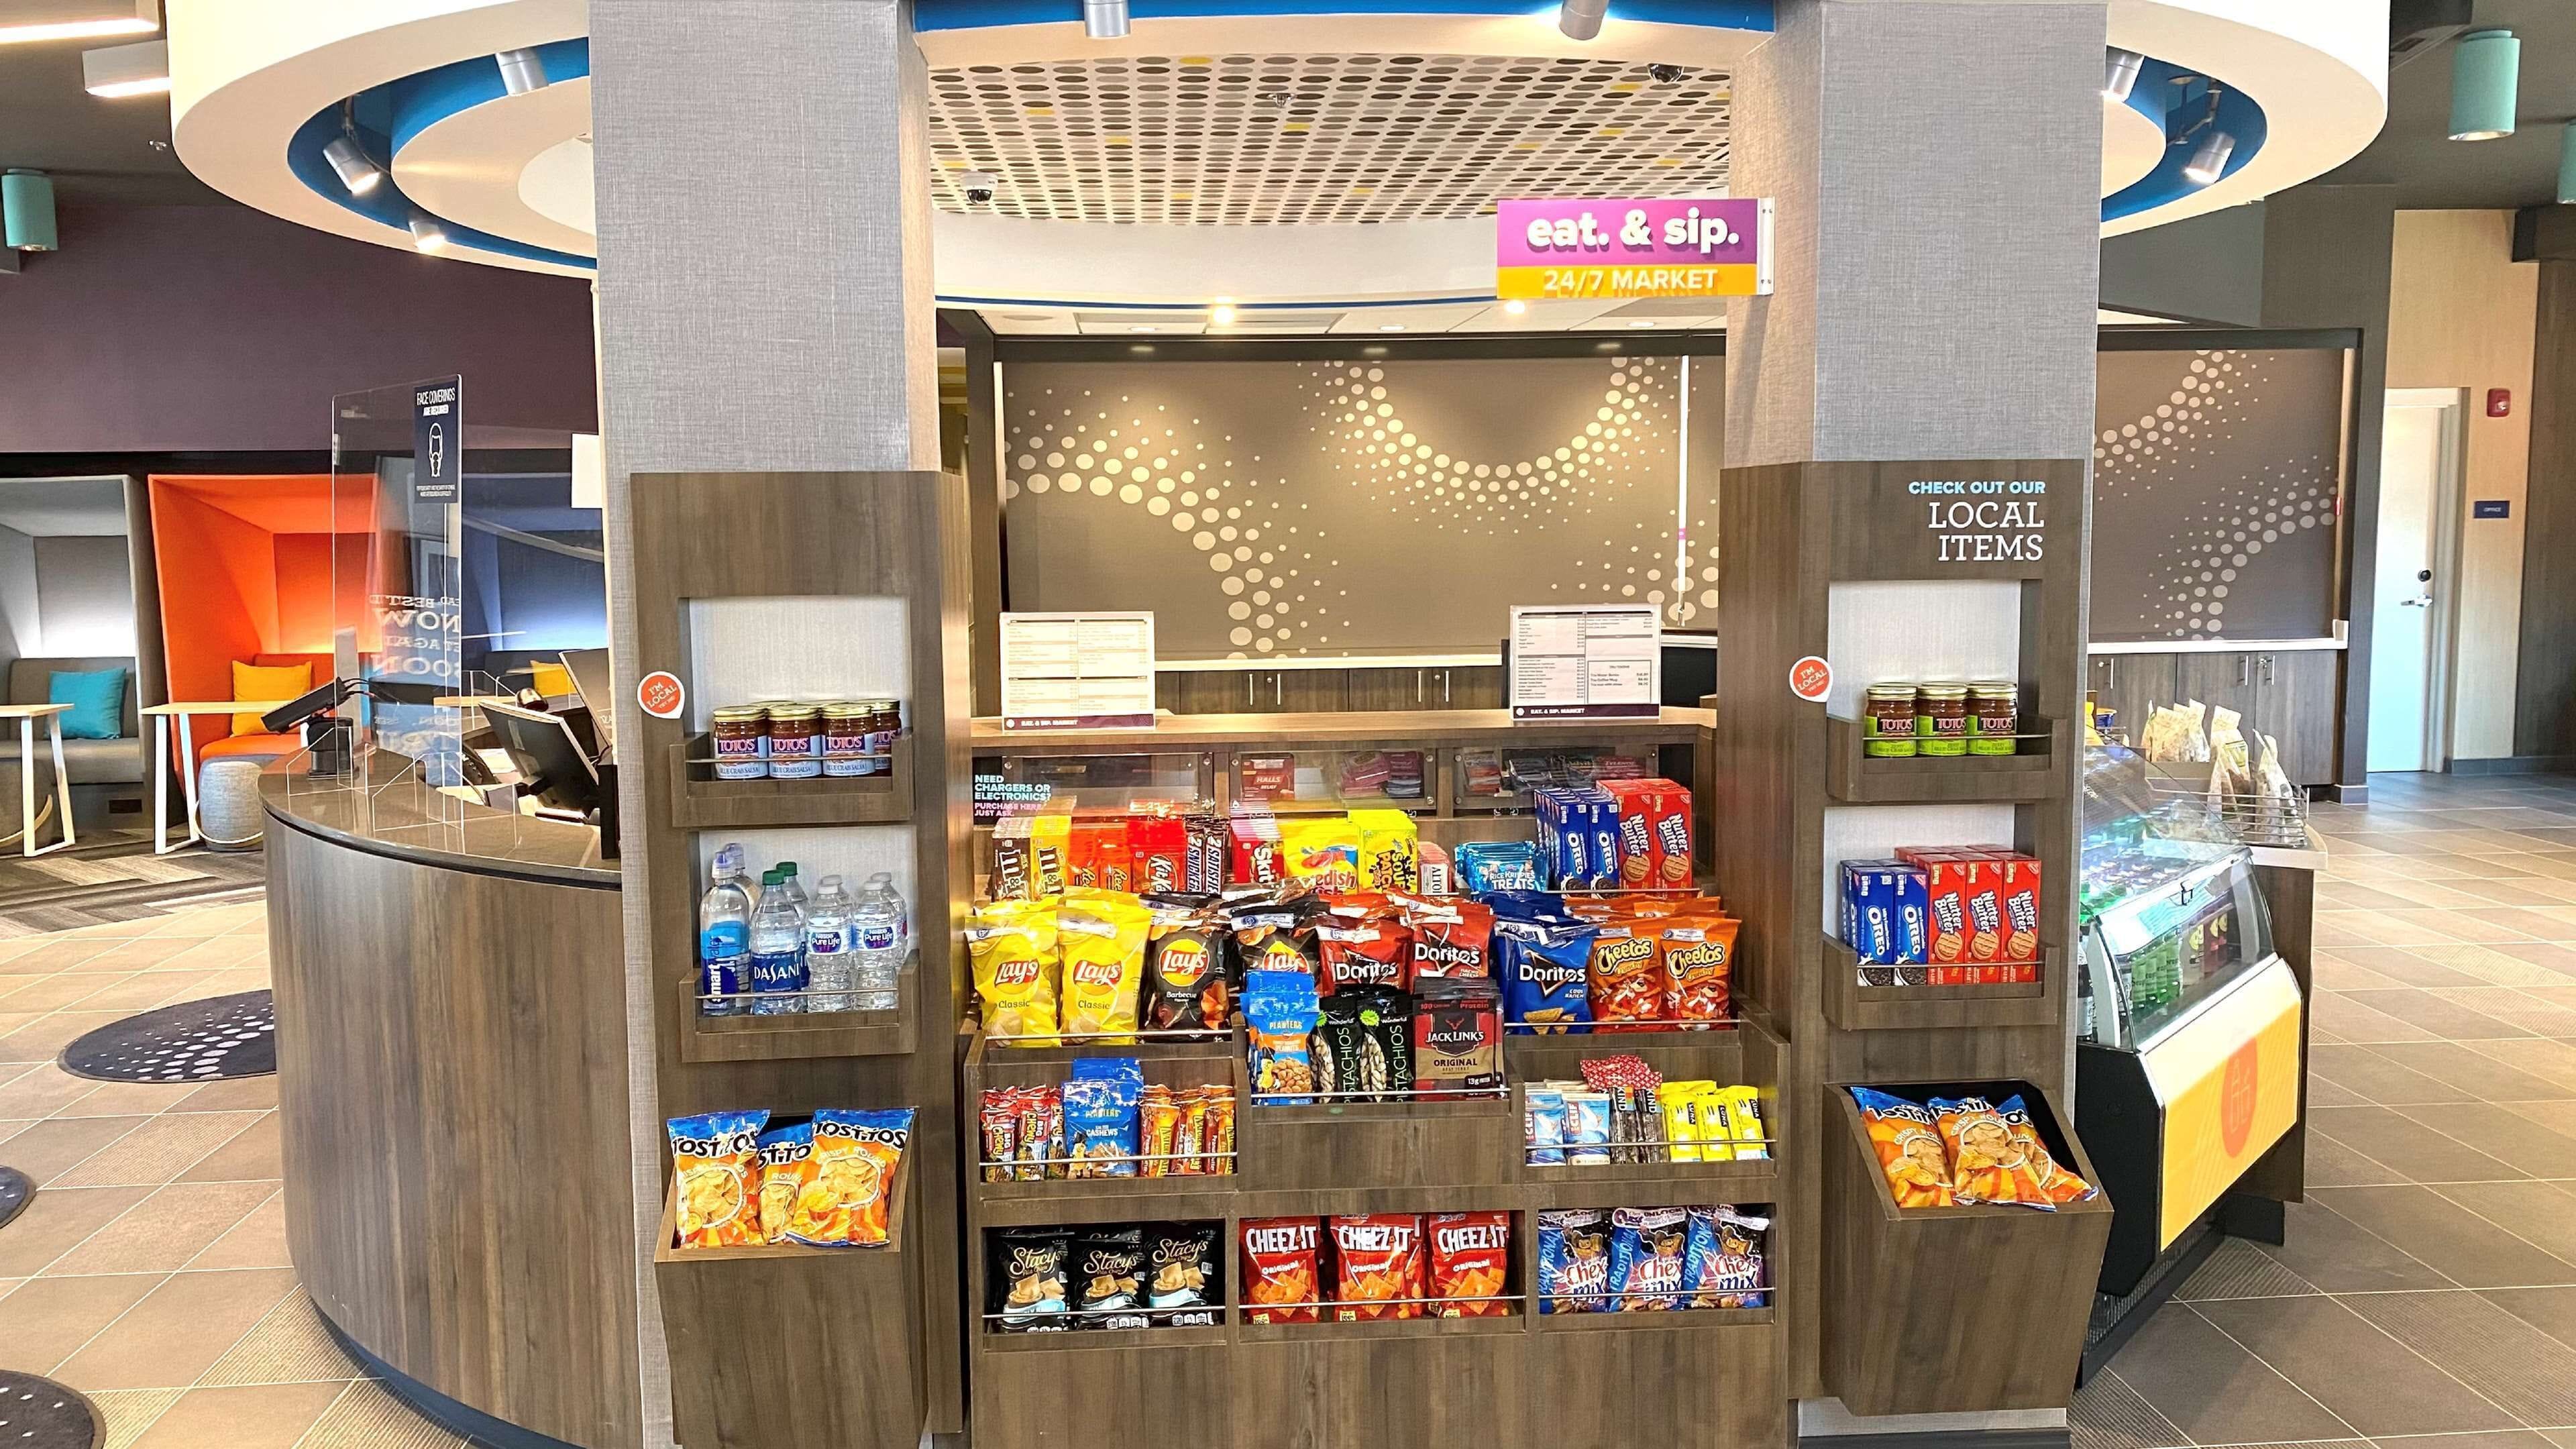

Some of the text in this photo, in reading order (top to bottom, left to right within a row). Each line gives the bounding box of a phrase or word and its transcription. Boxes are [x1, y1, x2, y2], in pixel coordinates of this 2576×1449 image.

[1527, 207, 1739, 253] eat. & sip.
[1544, 269, 1717, 290] 24/7 MARKET
[417, 387, 455, 406] FACE COVERINGS
[1909, 481, 2046, 494] CHECK OUT OUR
[1928, 501, 2045, 529] LOCAL
[1938, 534, 2044, 561] ITEMS
[1797, 669, 1827, 691] LOCAL
[1801, 665, 1815, 679] I'M
[646, 685, 677, 708] LOCAL
[648, 682, 663, 696] I'M
[975, 775, 1004, 783] NEED
[975, 784, 1051, 792] CHARGERS OR
[975, 792, 1052, 801] ELECTRONICS?
[1619, 820, 1642, 856] Butter
[1629, 814, 1650, 851] Nutter
[1658, 820, 1680, 855] Butter
[1669, 814, 1688, 851] Nutter
[1567, 833, 1582, 874] OREO
[1598, 832, 1613, 873] OREO
[1149, 857, 1174, 893] KitKa
[1188, 847, 1201, 892] SNICKER
[1254, 847, 1273, 883] Skit
[1490, 872, 1503, 880] RICE
[1432, 867, 1442, 894] ALTOI
[1492, 879, 1535, 890] TREATS
[1934, 899, 1954, 934] Butter
[1945, 892, 1962, 928] Nutter
[1970, 897, 1990, 932] Butter
[1981, 891, 1999, 927] Nutter
[2008, 896, 2028, 932] Butter
[2019, 891, 2036, 927] Nutter
[828, 936, 841, 947] Life
[881, 932, 893, 942] Life
[1868, 907, 1885, 955] OREO
[1904, 906, 1921, 955] OREO
[1162, 950, 1207, 975] Lay's
[1415, 943, 1480, 964] Doritos
[1595, 940, 1652, 974] Cheetos
[1670, 943, 1725, 978] Cheetos
[754, 963, 800, 983] DASANI
[996, 961, 1038, 985] Lay's
[1075, 960, 1122, 985] Lay's
[1336, 962, 1397, 980] Doritos
[1520, 965, 1585, 983] Doritos
[998, 1000, 1030, 1009] Classic
[1078, 1000, 1111, 1010] Classic
[1167, 991, 1197, 999] Barbecue
[1269, 1020, 1303, 1030] PLANTERS
[1426, 1032, 1453, 1042] JACK
[1434, 1059, 1477, 1067] ORIGINAL
[1617, 1087, 1626, 1111] KIND
[1647, 1089, 1656, 1113] KIND
[1751, 1100, 1760, 1118] LUNA
[1570, 1104, 1579, 1126] CLIF
[814, 1122, 908, 1149] TOSTITOS
[1086, 1128, 1118, 1136] CASHEWS
[1644, 1208, 1682, 1217] UNLOCK
[1010, 1247, 1063, 1275] Stacy's
[1152, 1238, 1208, 1263] Stacy's
[1083, 1250, 1138, 1274] Stacy's
[1261, 1260, 1299, 1275] ORIGINAL
[1352, 1261, 1389, 1273] ORIGINAL
[1453, 1260, 1491, 1273] ORIGINAL
[1640, 1258, 1682, 1280] Chex
[1715, 1254, 1755, 1275] Chex
[1566, 1263, 1605, 1285] Chex
